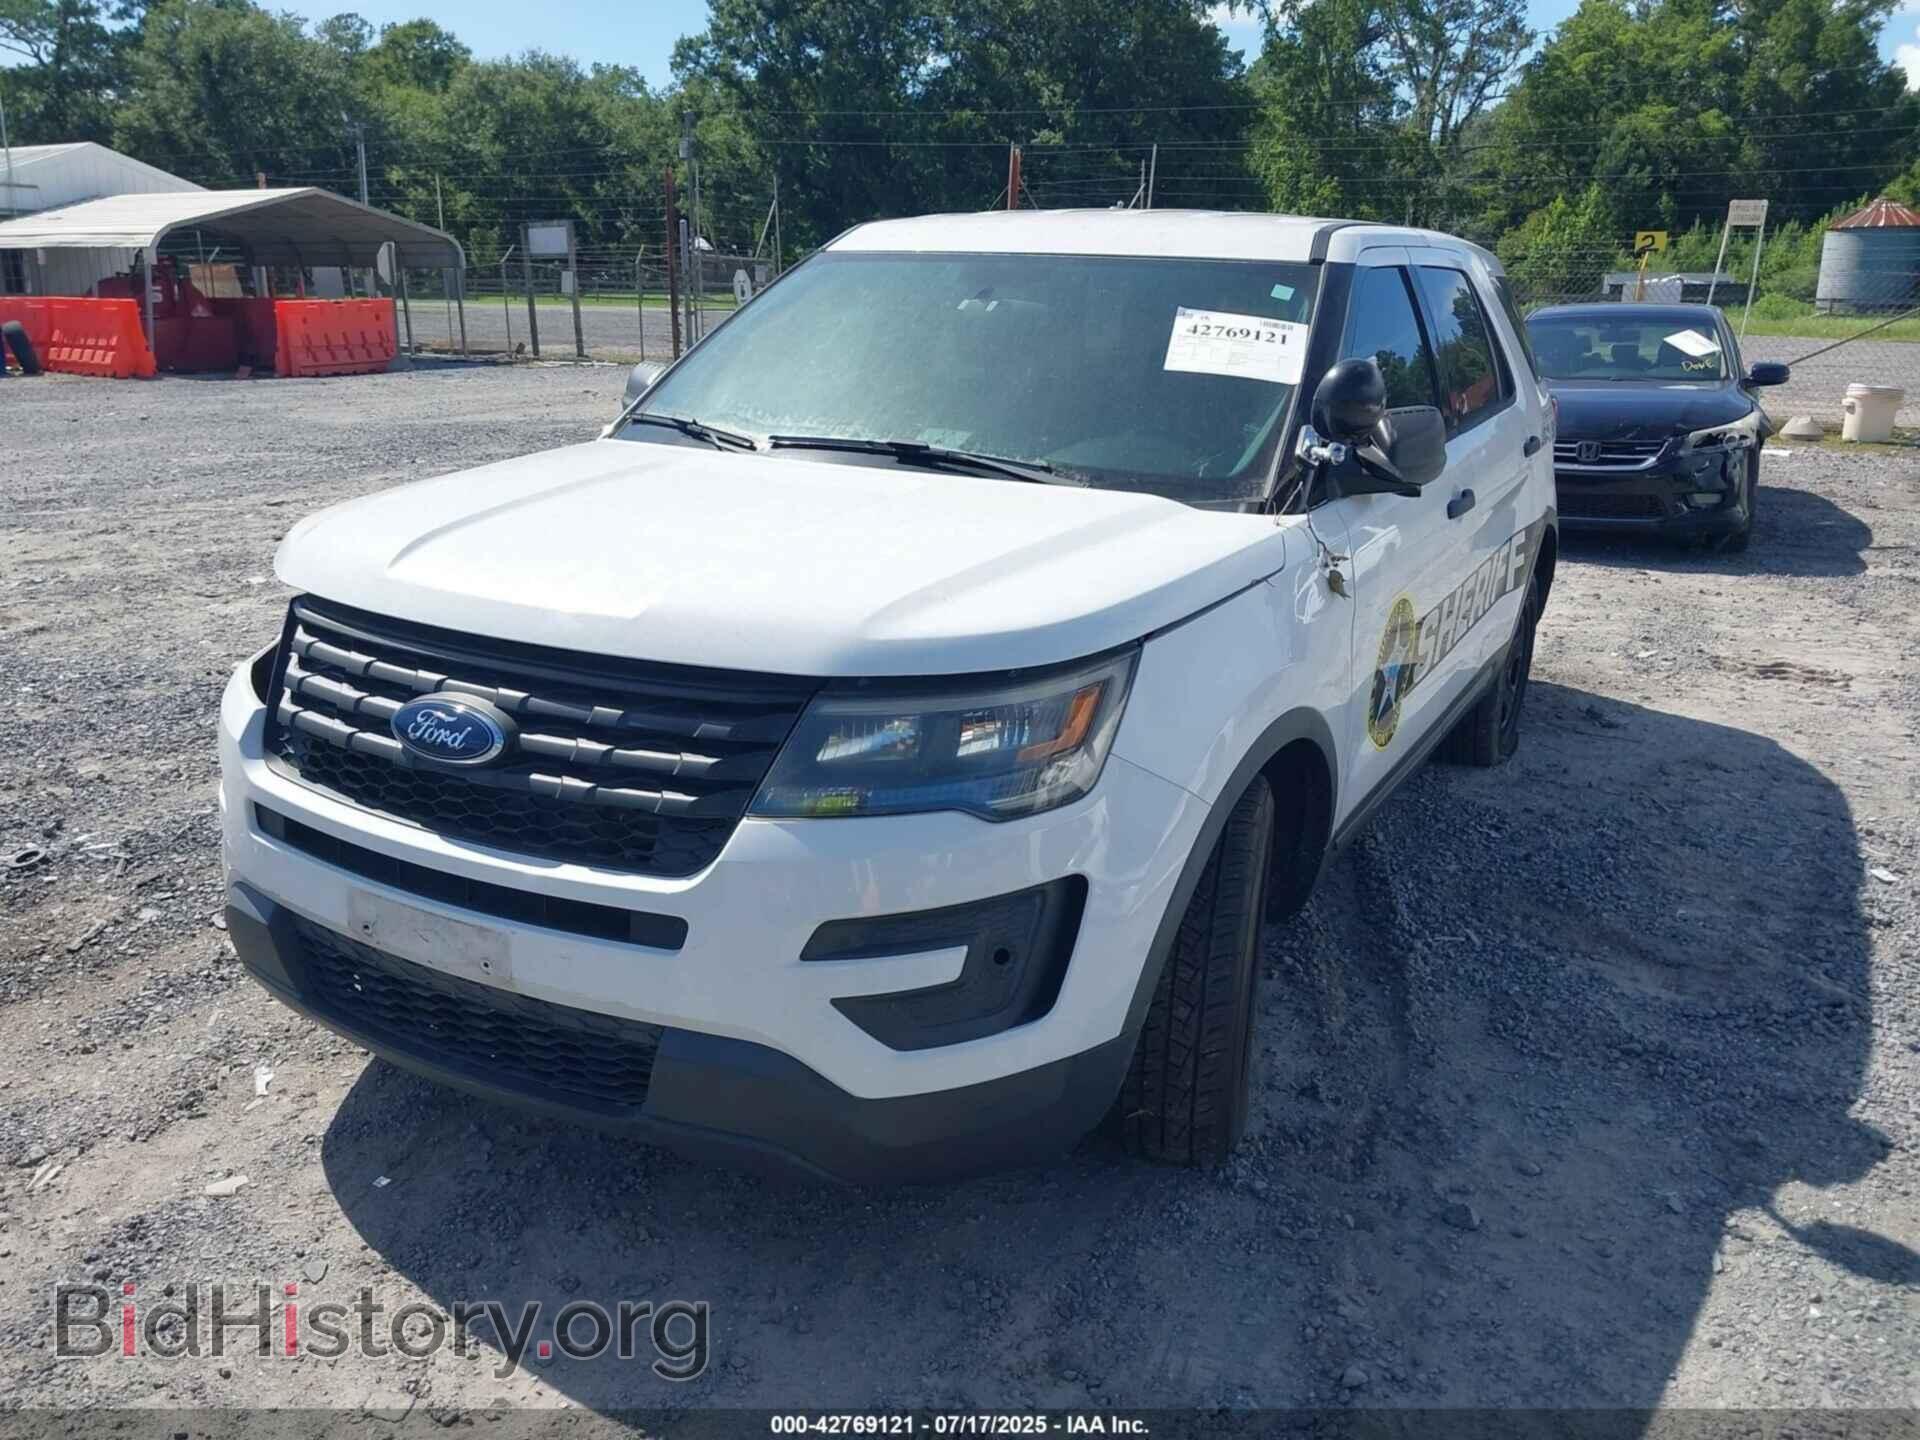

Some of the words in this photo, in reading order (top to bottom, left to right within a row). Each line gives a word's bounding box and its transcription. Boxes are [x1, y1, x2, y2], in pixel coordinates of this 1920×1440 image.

[1186, 323, 1288, 345] 42769121
[1412, 529, 1526, 685] SHERIFF
[407, 709, 473, 751] Ford
